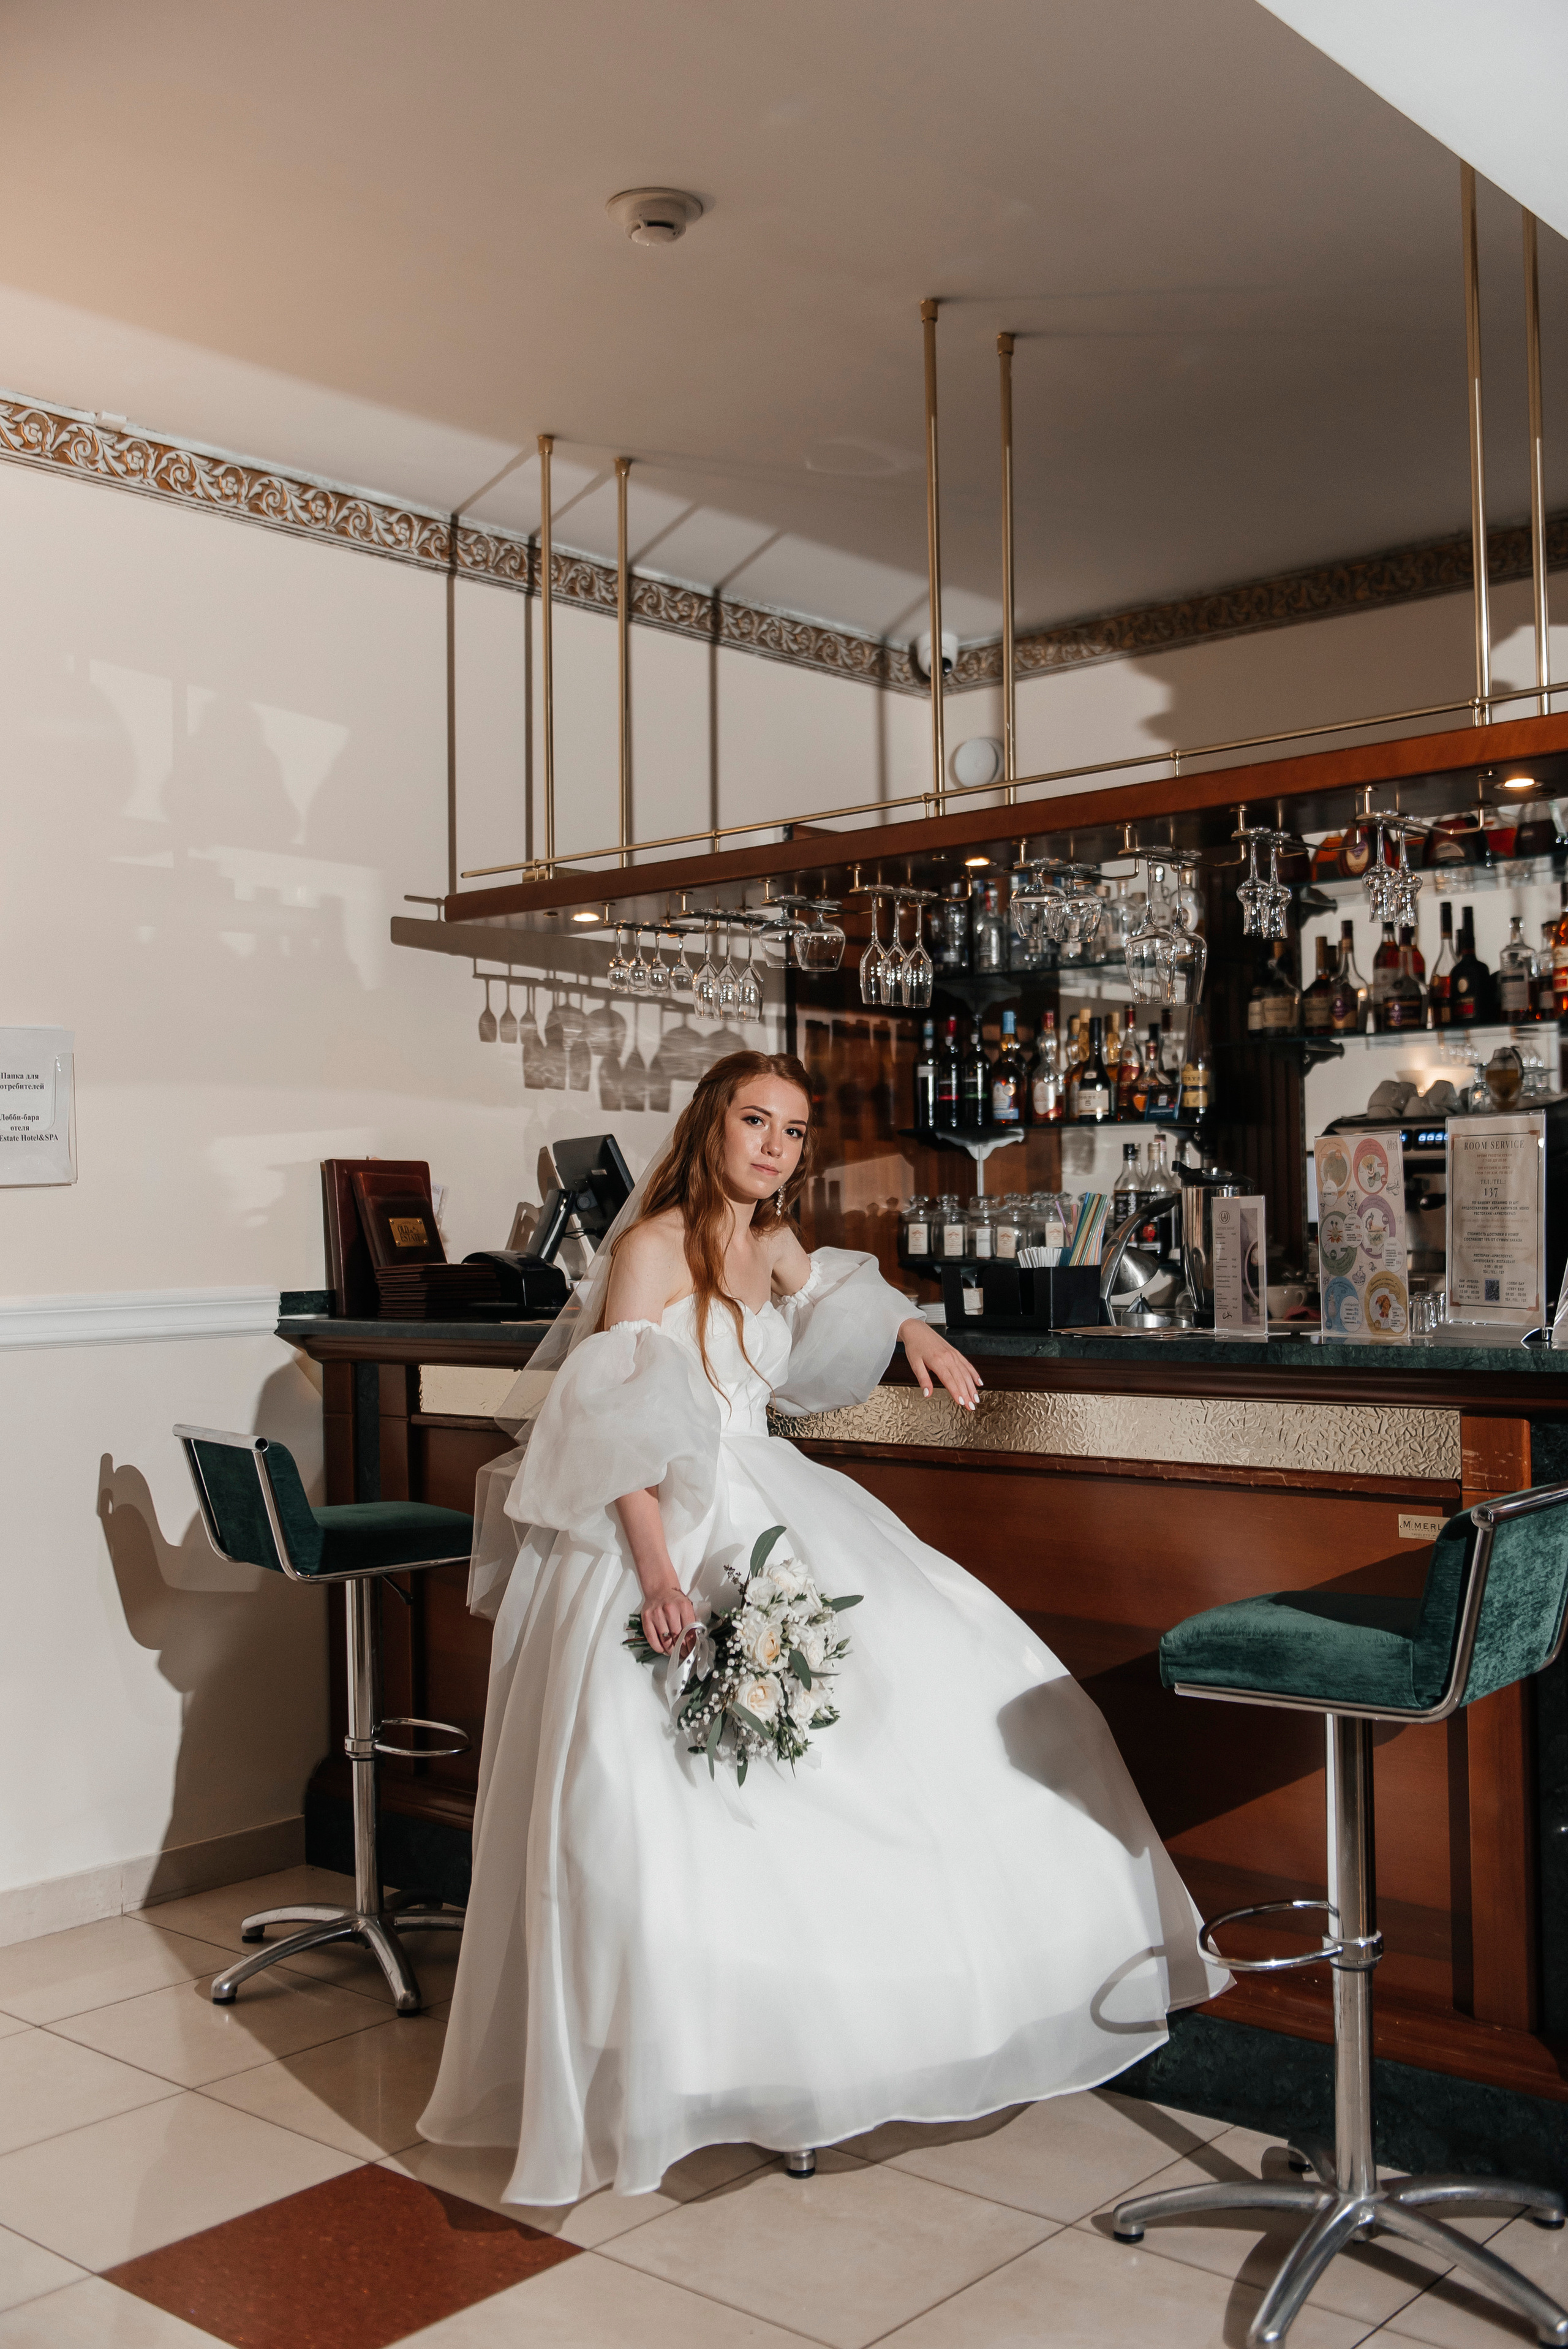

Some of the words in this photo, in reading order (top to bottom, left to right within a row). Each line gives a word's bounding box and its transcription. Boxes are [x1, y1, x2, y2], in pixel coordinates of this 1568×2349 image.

[1464, 1141, 1487, 1150] ROOM
[1490, 1140, 1524, 1149] SERVICE
[1484, 1188, 1498, 1197] 137
[398, 1225, 409, 1234] OLD
